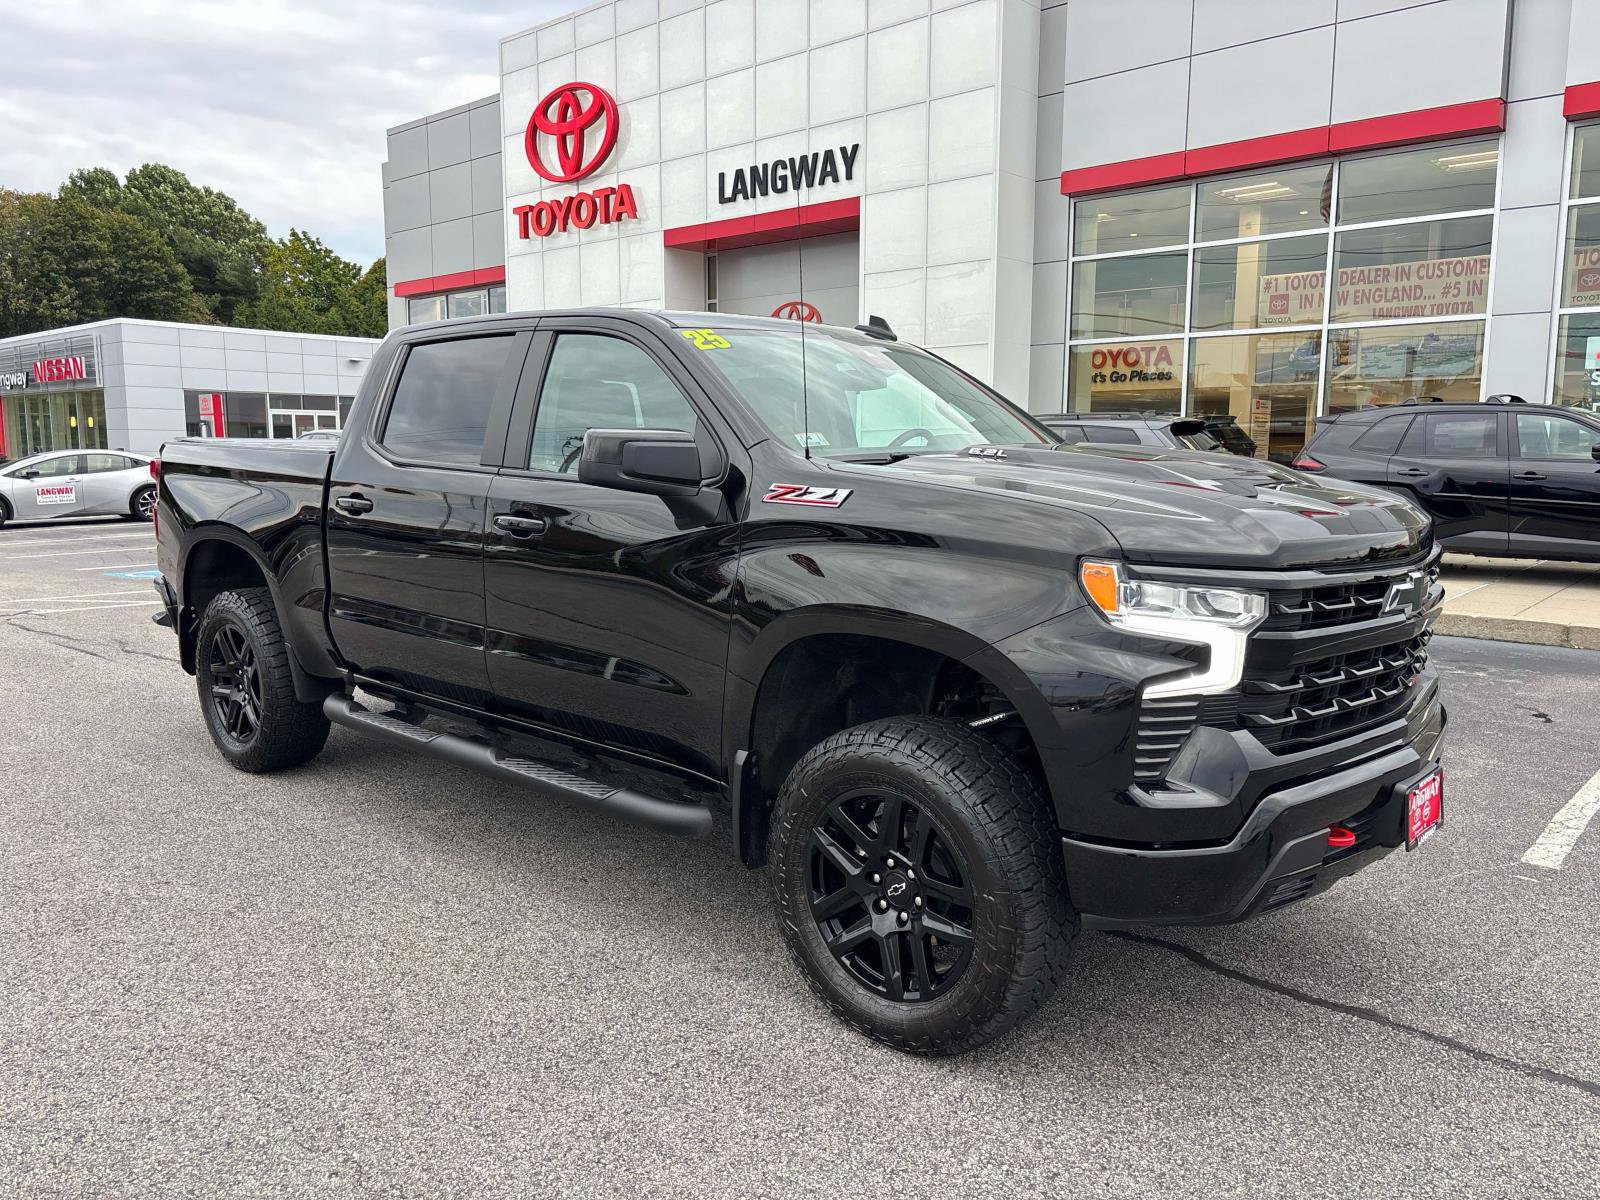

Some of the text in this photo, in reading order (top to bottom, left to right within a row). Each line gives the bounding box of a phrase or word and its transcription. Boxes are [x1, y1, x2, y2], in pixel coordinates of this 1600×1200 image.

[718, 143, 860, 204] LANGWAY
[512, 183, 639, 240] TOYOTA
[1263, 257, 1491, 293] #1 TOYOT DEALER IN CUSTOME
[1298, 279, 1484, 310] IN NW ENGLAND... #5 IN
[1571, 294, 1600, 303] TOYOT
[1264, 316, 1292, 324] TOYOTA
[1372, 301, 1474, 320] LANGWAY TOYOTA
[681, 328, 731, 351] 25
[33, 355, 86, 383] NISSAN
[1091, 345, 1173, 370] OYOTA
[0, 371, 27, 390] ngway
[1091, 369, 1173, 384] t's Go Places
[36, 486, 74, 496] LANGWAY
[762, 483, 854, 509] Z71
